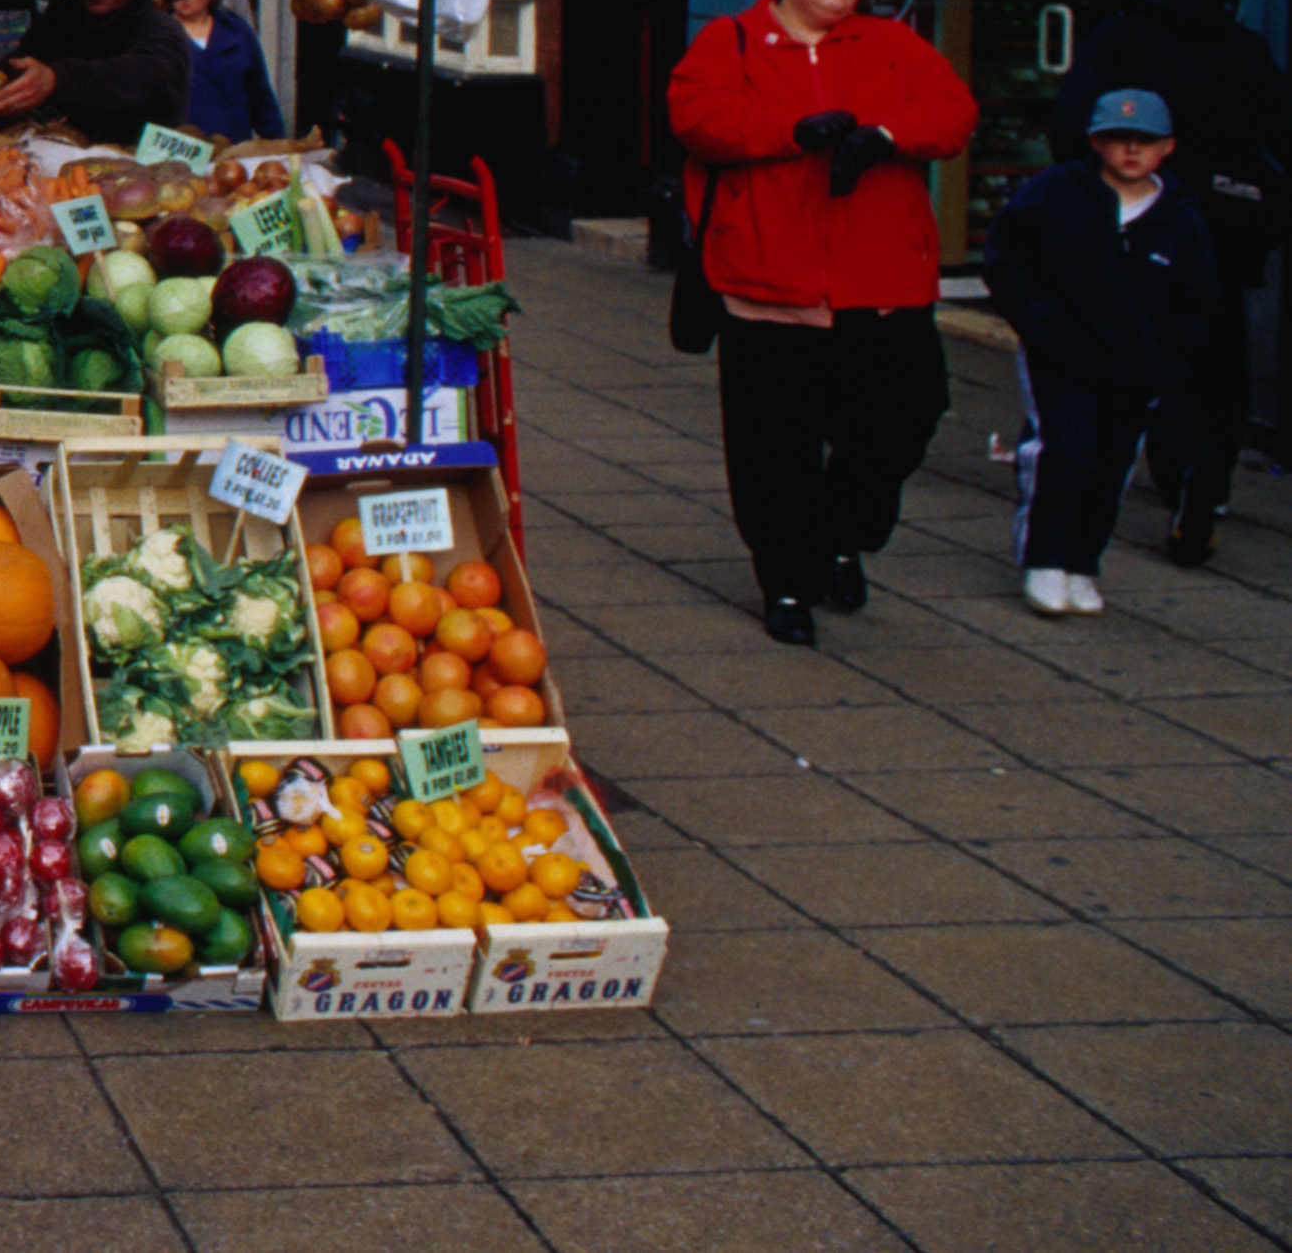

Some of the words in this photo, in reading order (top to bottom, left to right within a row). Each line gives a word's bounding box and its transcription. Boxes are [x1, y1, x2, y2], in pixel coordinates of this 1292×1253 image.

[153, 131, 203, 161] TURNIP
[252, 198, 292, 236] LEEKS
[234, 450, 290, 490] COLLIES
[335, 451, 437, 470] ADANAR
[370, 498, 439, 527] GRAPEFRUIT
[385, 532, 408, 546] FOR
[419, 729, 471, 775] TANGIES
[314, 988, 454, 1014] GRAGON
[506, 976, 643, 1005] GRAGON
